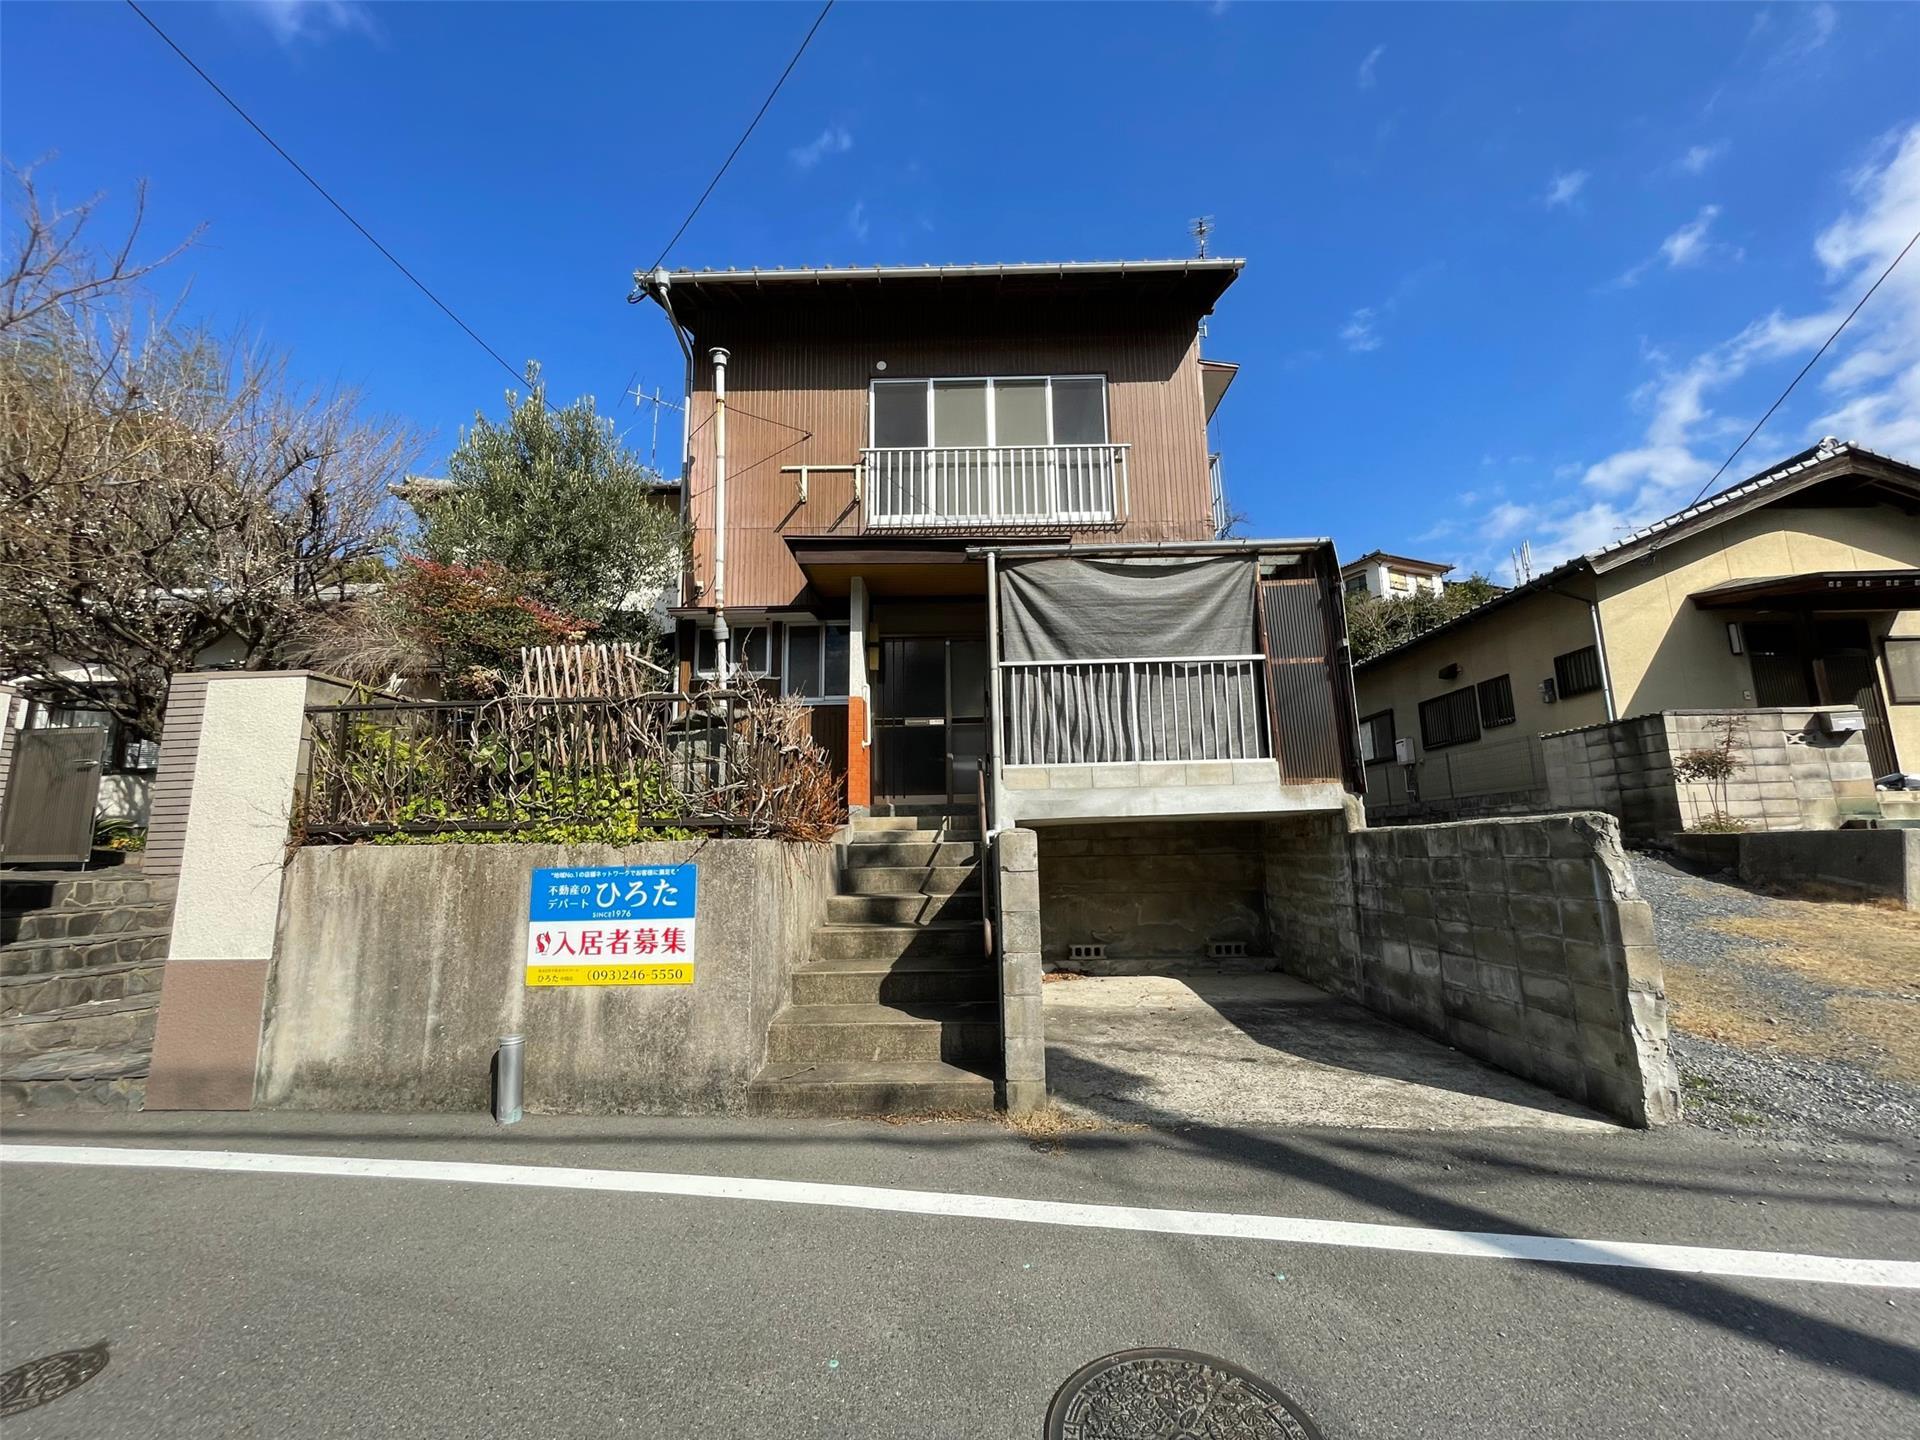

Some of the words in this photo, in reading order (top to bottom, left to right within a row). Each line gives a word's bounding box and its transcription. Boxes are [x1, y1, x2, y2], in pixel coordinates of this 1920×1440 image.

[548, 885, 591, 896] 不動産の
[596, 879, 678, 907] ひろた
[548, 898, 589, 910] デパート
[553, 927, 686, 956] 入居者募集
